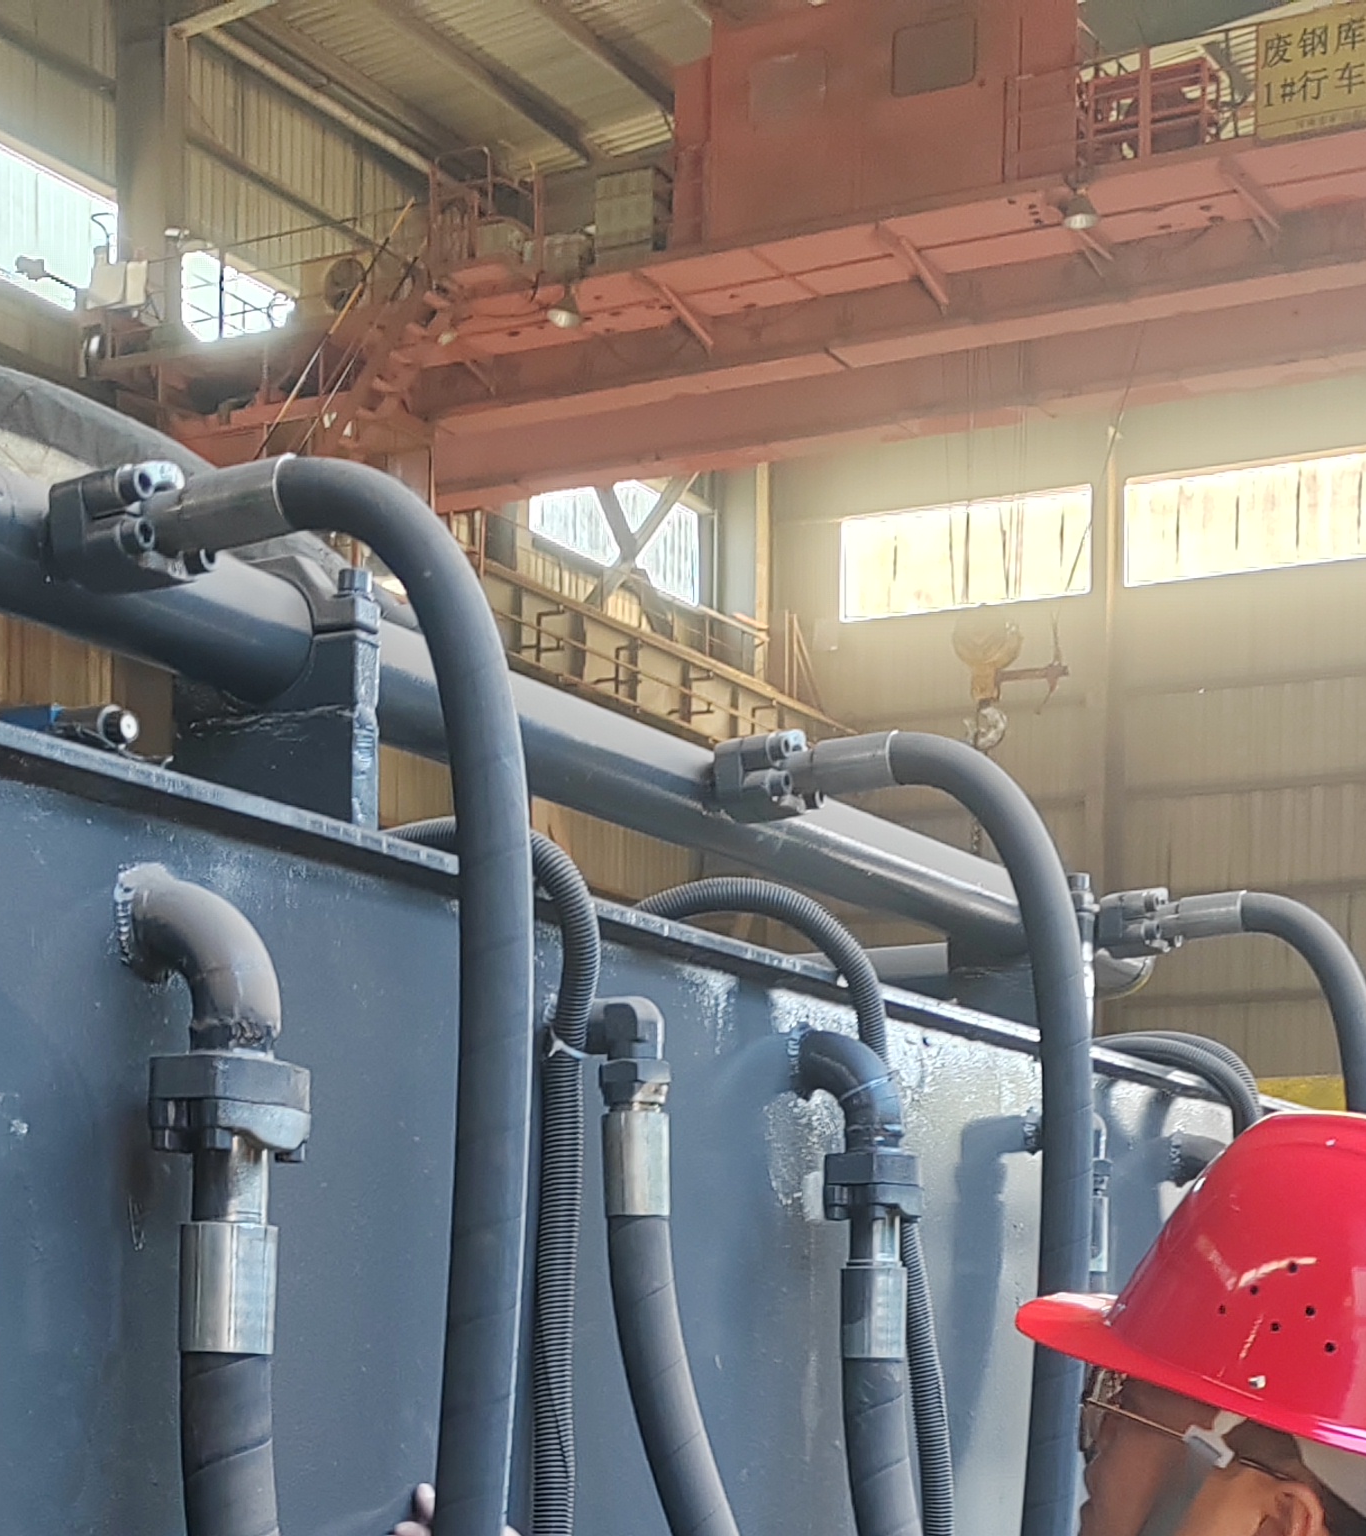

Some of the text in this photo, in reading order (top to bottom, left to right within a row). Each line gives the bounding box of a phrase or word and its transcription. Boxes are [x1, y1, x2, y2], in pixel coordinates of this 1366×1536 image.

[1261, 16, 1366, 69] 废钢库
[1262, 61, 1366, 108] 1#行车
